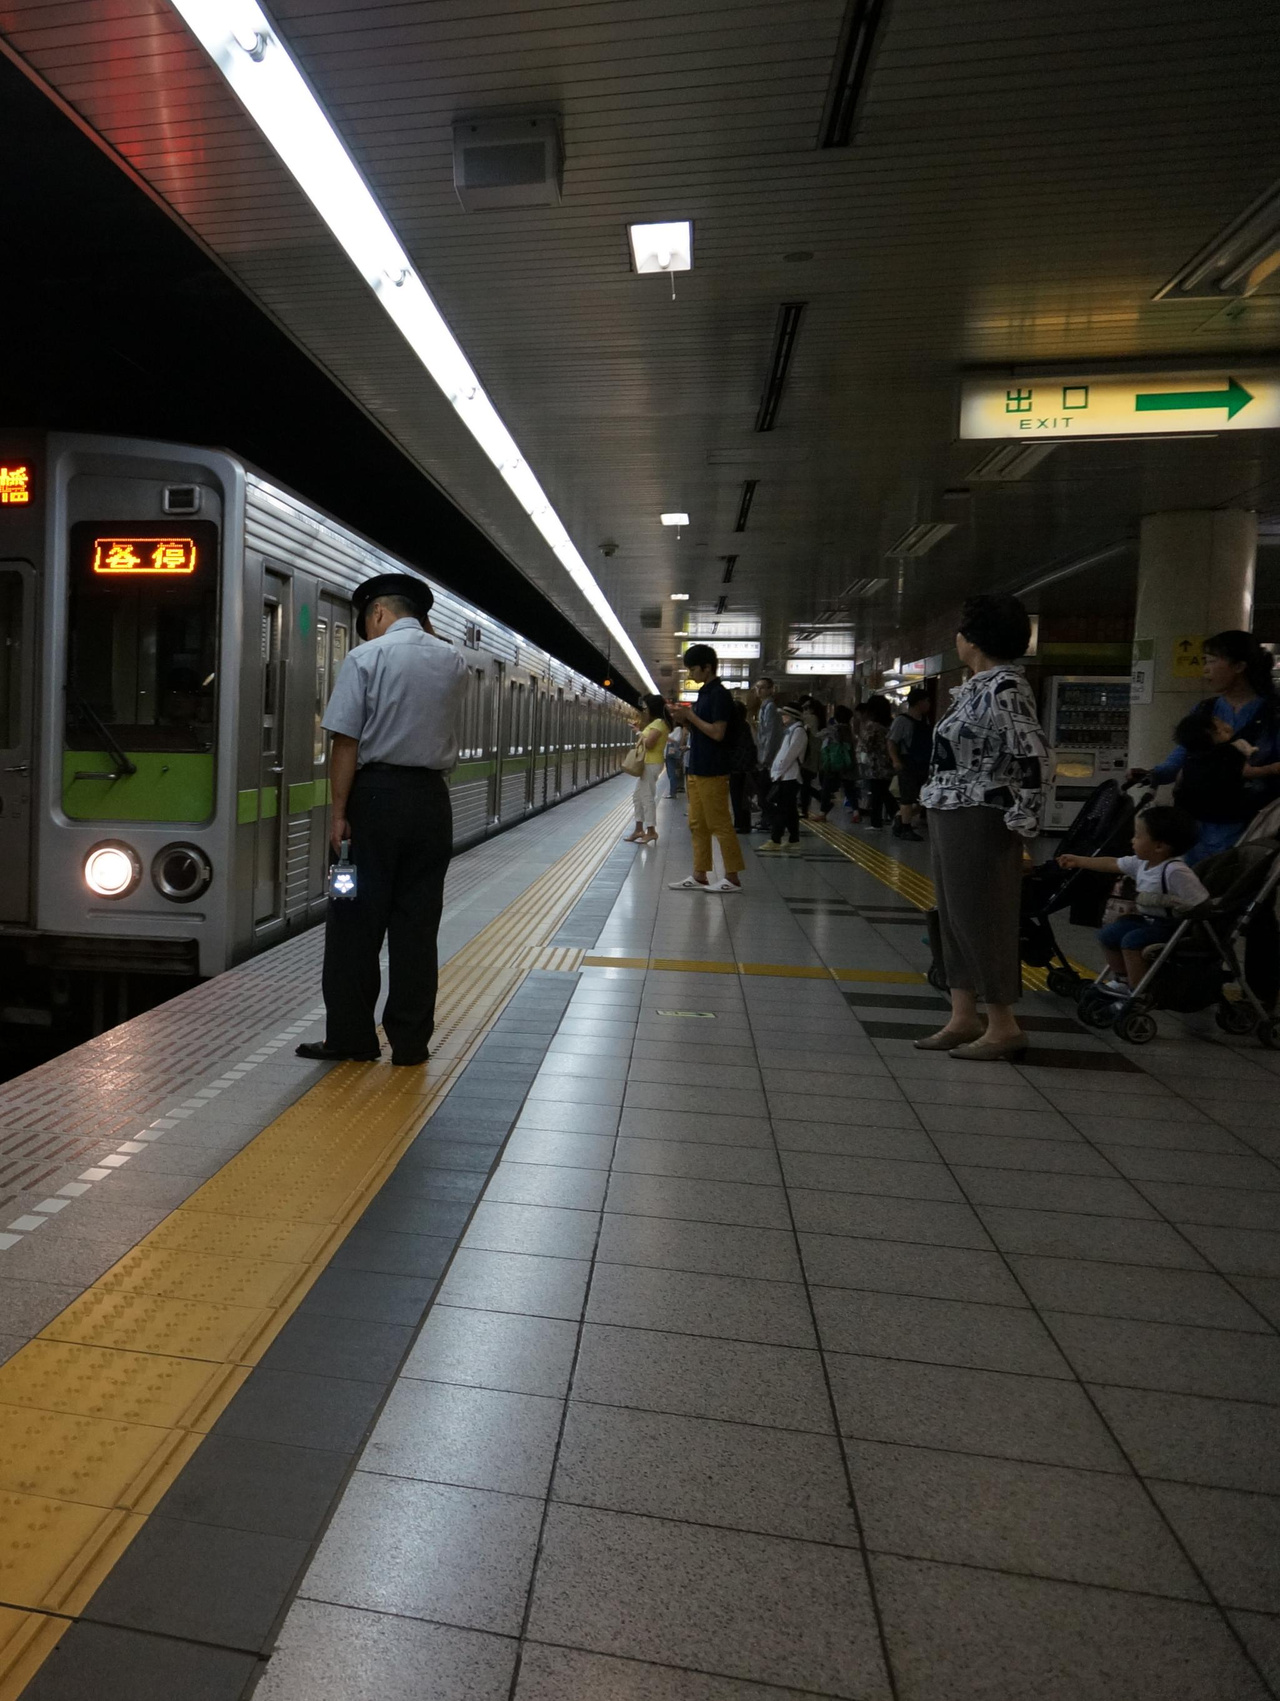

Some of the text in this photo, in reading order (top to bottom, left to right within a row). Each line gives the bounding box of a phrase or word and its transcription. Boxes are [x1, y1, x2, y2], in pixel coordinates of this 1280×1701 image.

[1006, 385, 1089, 414] 出口
[1020, 417, 1074, 430] EXIT
[108, 542, 186, 569] 各停
